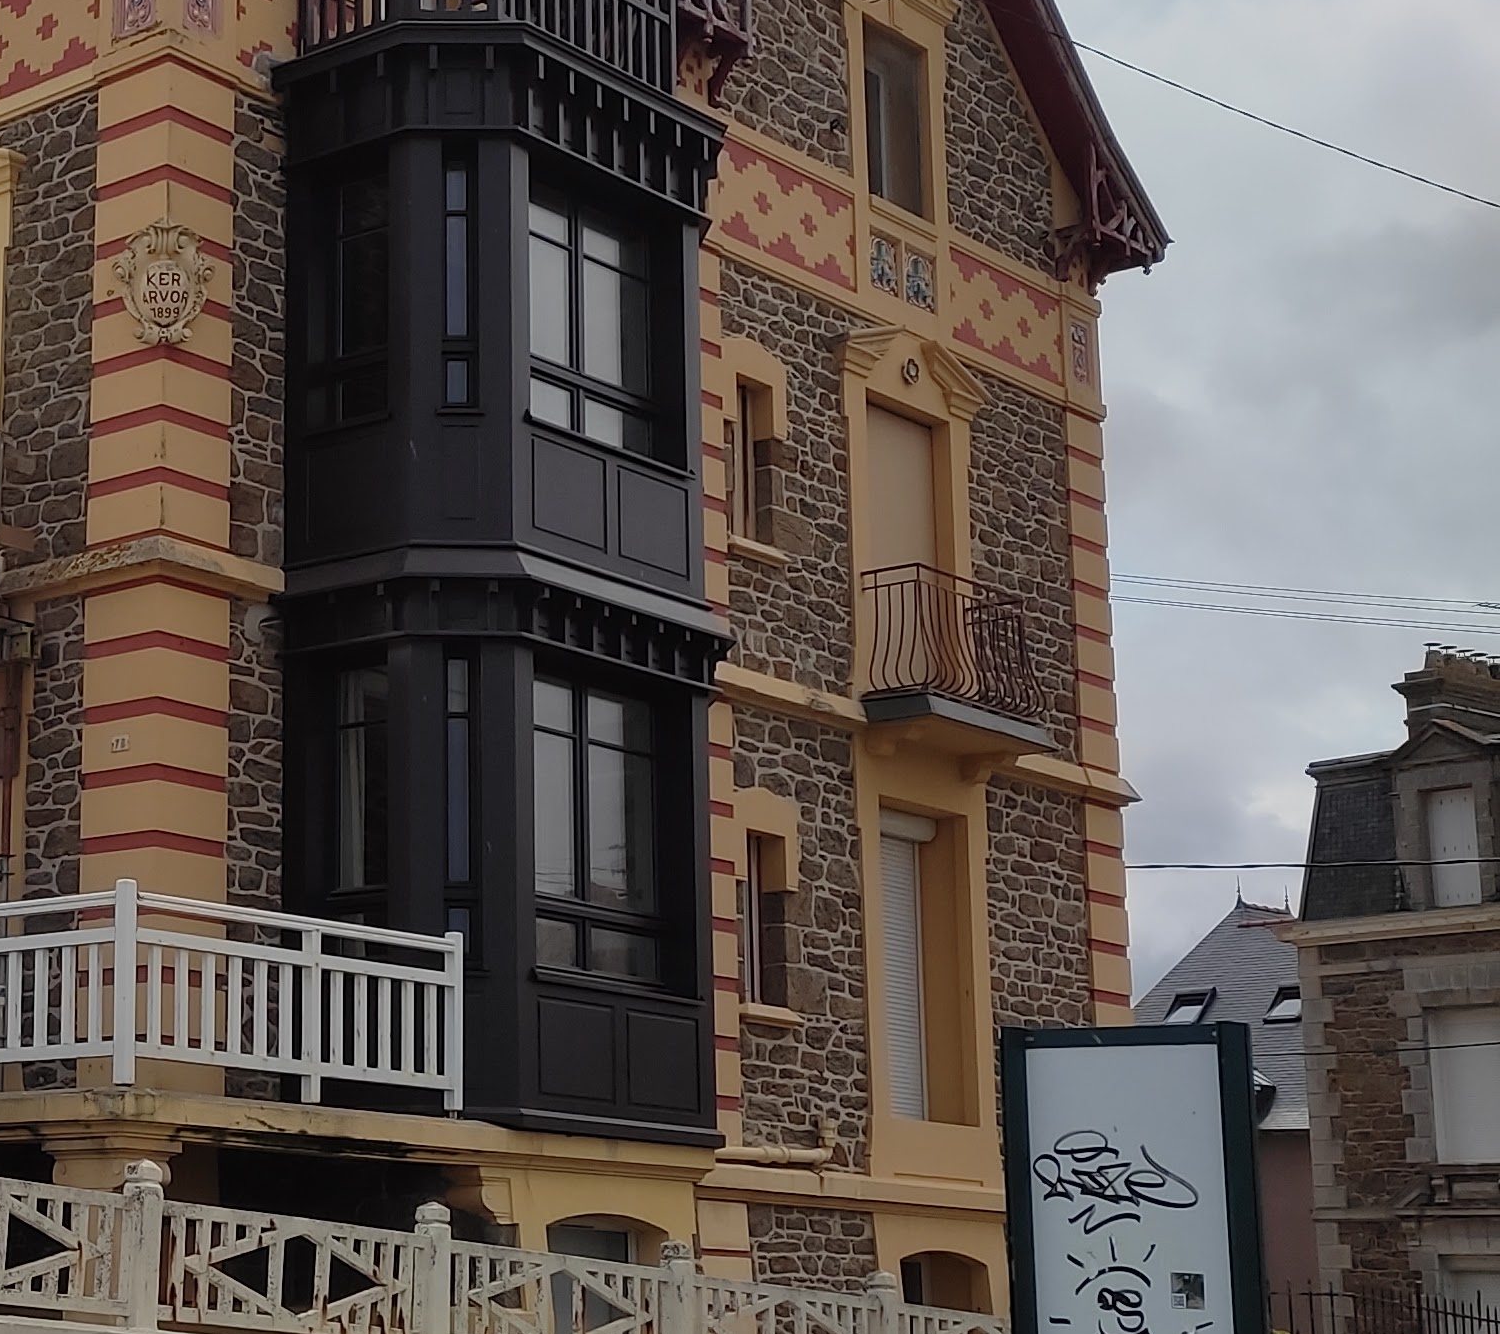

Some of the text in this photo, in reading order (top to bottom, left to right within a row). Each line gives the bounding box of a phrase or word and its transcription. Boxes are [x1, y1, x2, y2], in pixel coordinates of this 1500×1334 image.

[146, 272, 181, 289] KER
[143, 290, 189, 307] ARVOR
[150, 306, 180, 319] 1899
